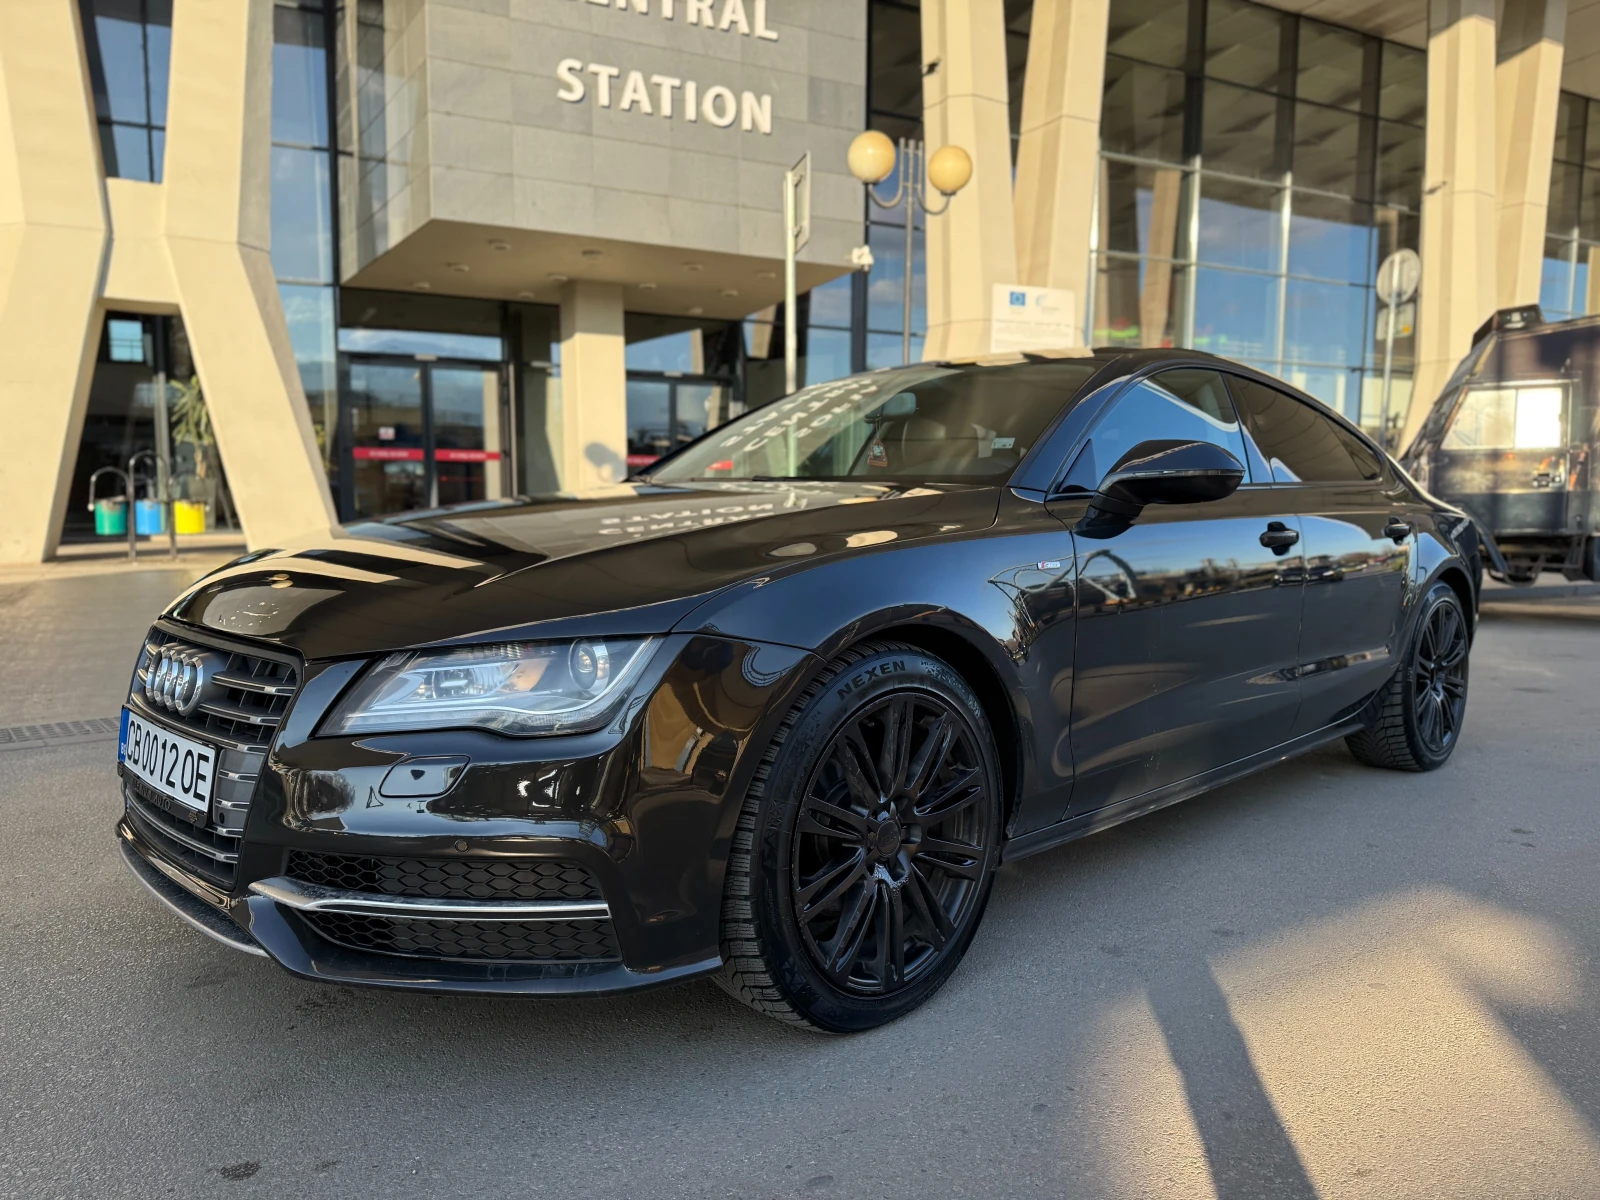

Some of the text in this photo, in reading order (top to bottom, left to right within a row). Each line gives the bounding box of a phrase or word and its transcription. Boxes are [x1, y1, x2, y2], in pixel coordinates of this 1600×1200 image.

[584, 0, 779, 42] TRAL
[555, 57, 773, 136] STATION
[836, 660, 906, 701] NEXEN
